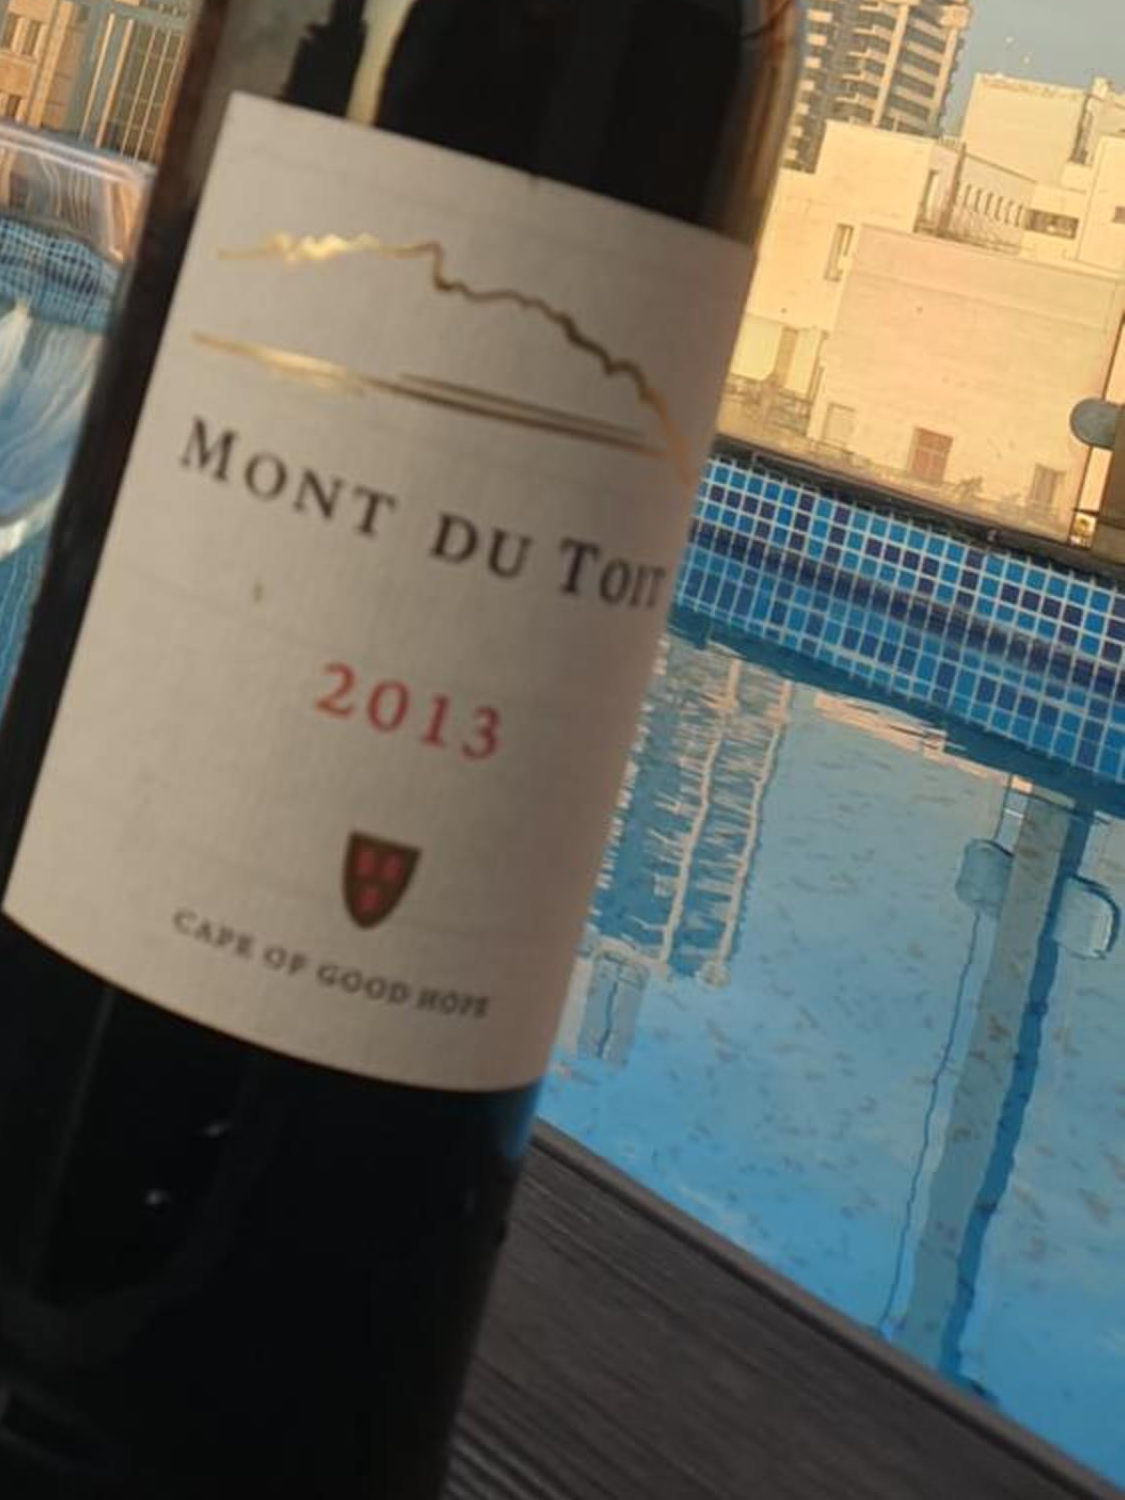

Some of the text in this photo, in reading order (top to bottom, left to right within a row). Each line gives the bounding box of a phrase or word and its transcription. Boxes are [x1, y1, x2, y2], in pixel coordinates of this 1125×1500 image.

[178, 415, 667, 610] MONT DU TOIT
[314, 661, 504, 761] 2013
[173, 909, 491, 1020] CAPE OF GOOD HOPE
